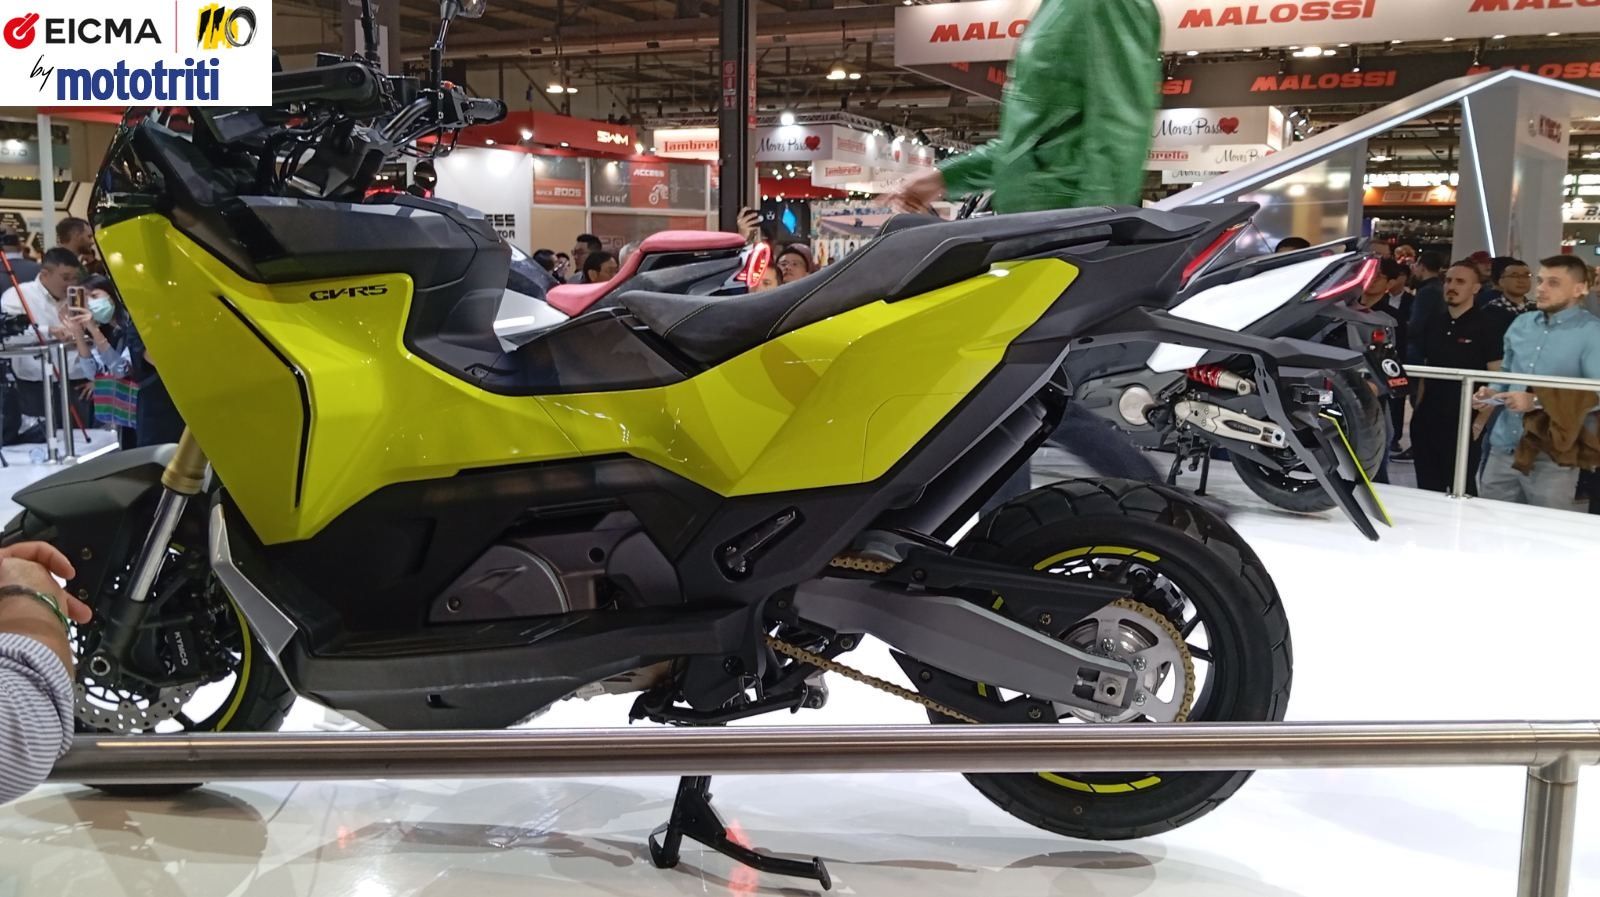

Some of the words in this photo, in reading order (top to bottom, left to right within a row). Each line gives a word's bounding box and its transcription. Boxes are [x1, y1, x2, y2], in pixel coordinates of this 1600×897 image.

[1178, 0, 1377, 29] MALOSSI
[929, 19, 1030, 43] MALO
[1250, 70, 1396, 92] MALOSSI
[1151, 118, 1192, 138] Moves
[596, 130, 629, 147] SWM
[632, 168, 665, 178] ACCESS
[554, 187, 581, 197] 2005
